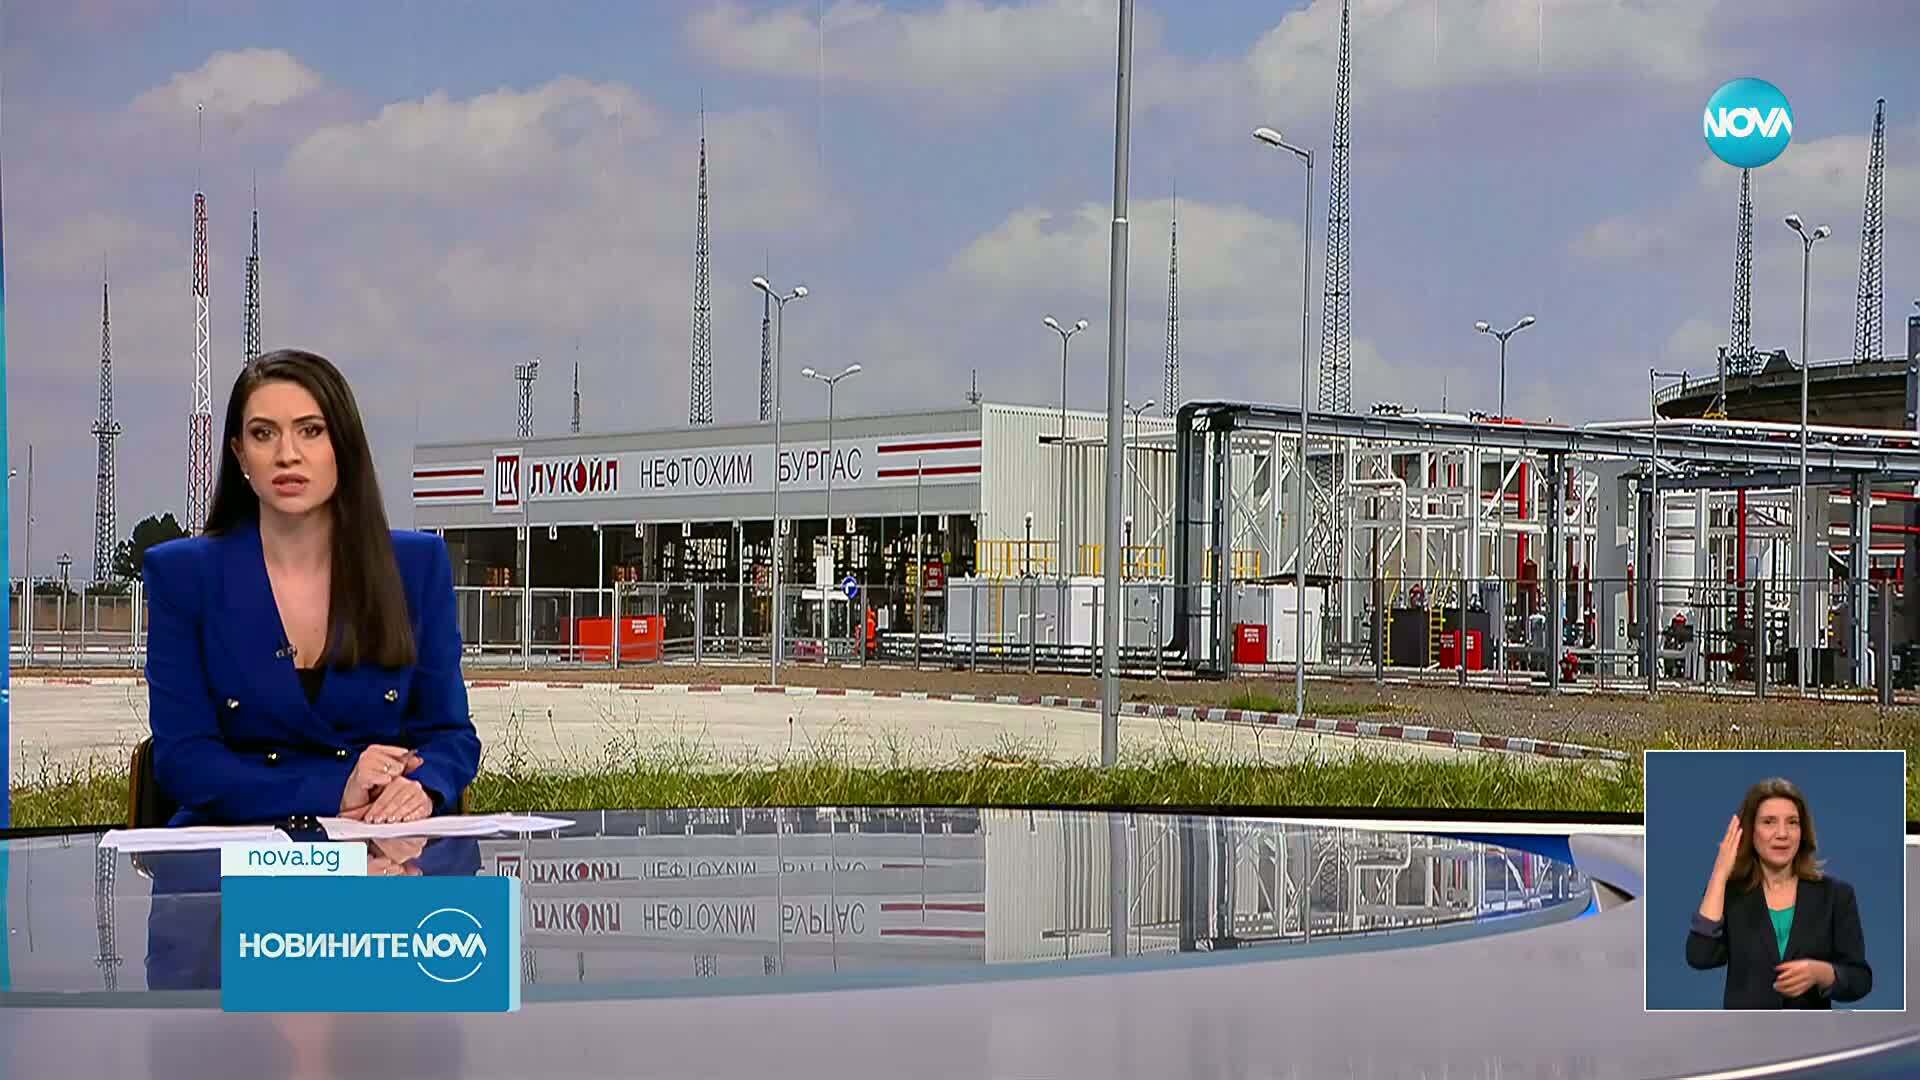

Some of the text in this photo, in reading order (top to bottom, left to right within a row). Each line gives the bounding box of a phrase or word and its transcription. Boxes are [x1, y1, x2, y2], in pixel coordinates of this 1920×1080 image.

[530, 456, 618, 495] ЛУКОЙЛ
[641, 453, 752, 488] НЕФТОХИМ
[779, 448, 862, 482] БУРГАС
